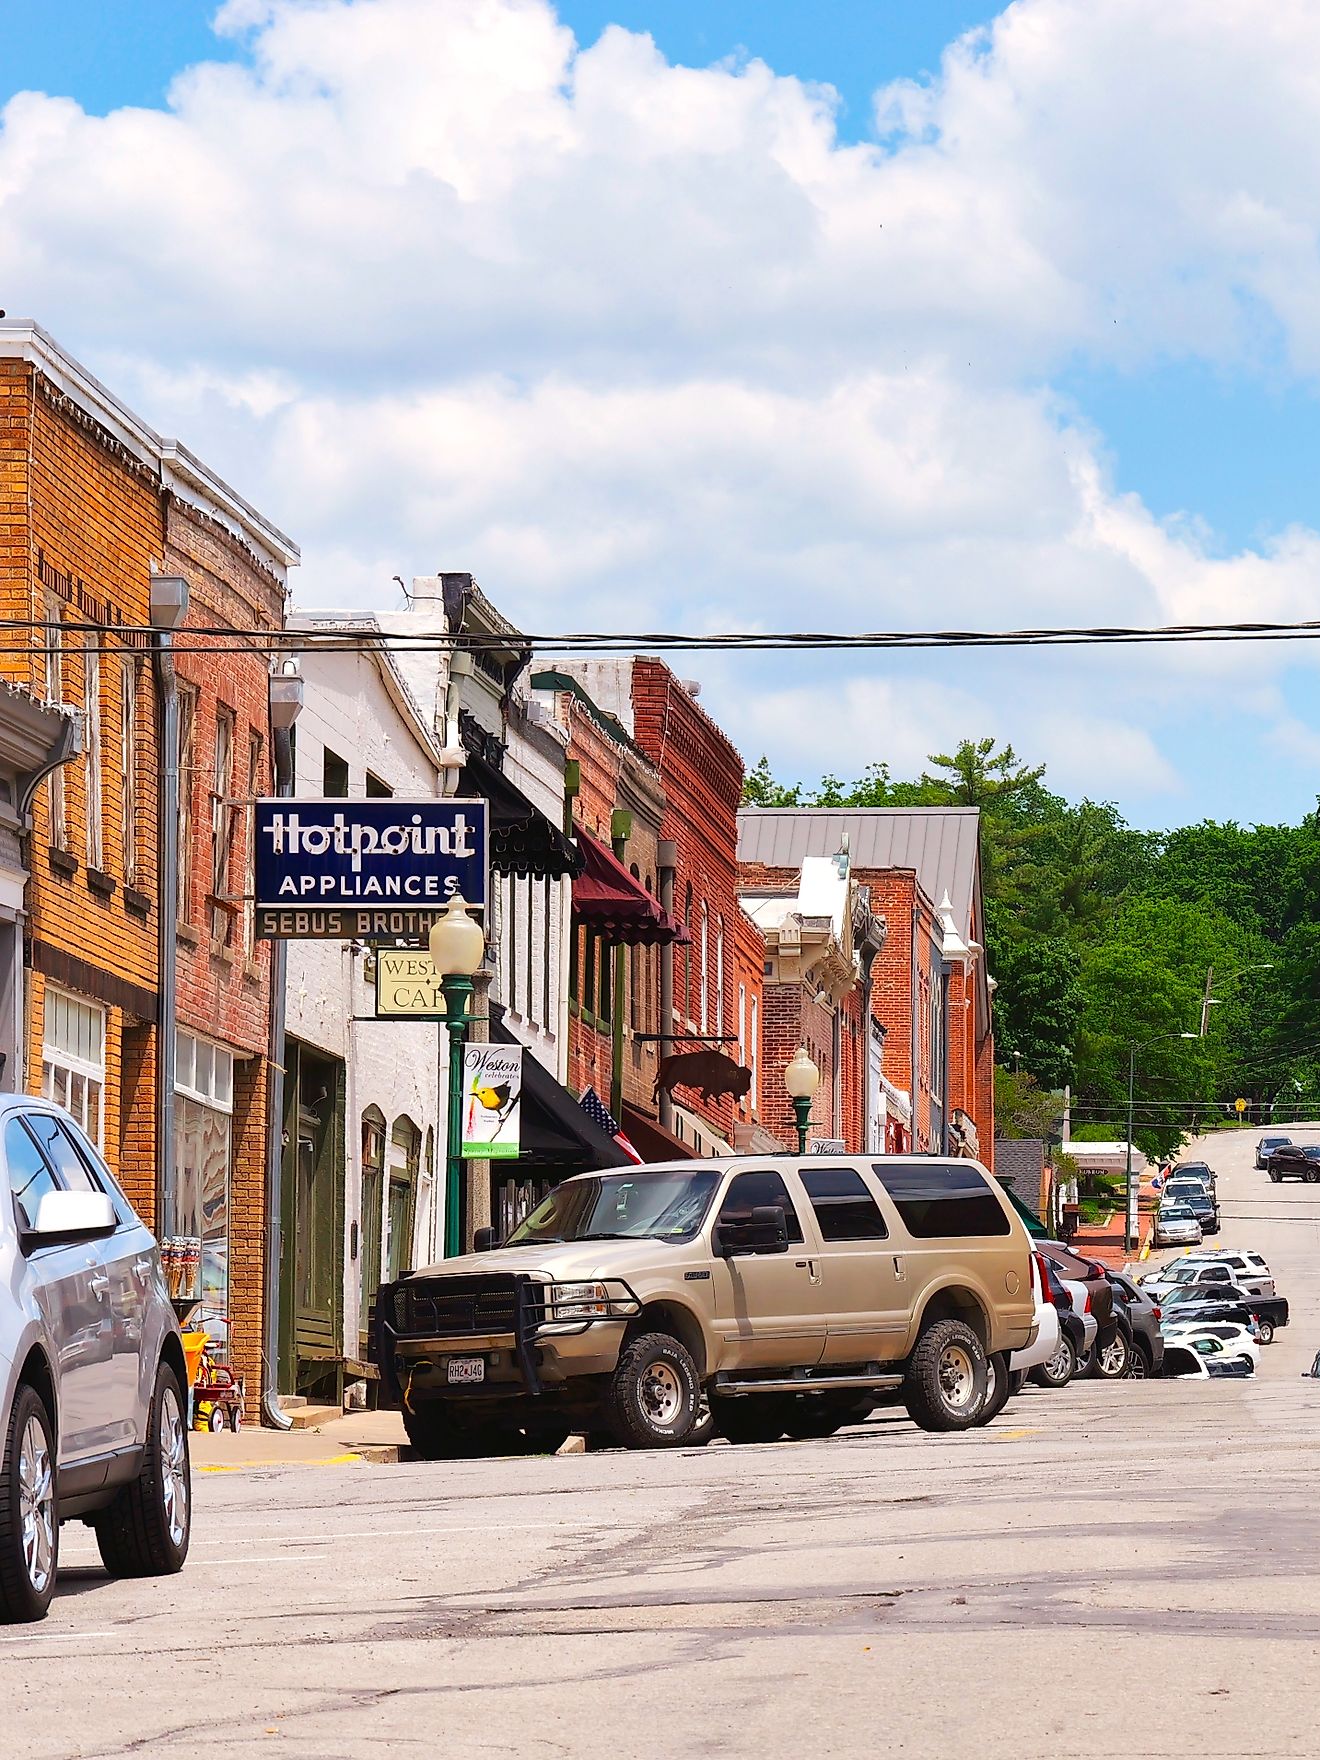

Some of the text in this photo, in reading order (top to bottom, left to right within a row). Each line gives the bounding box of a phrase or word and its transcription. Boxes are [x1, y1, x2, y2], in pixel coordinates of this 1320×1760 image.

[262, 813, 476, 872] Hotpoint
[278, 875, 459, 896] APPLIANCES
[263, 912, 342, 934] SEBUS
[385, 960, 437, 976] WEST
[393, 987, 443, 1008] CAF
[465, 1048, 520, 1072] Weston
[484, 1071, 520, 1079] celebrates
[662, 1348, 678, 1358] BAJA
[450, 1365, 464, 1377] RH2
